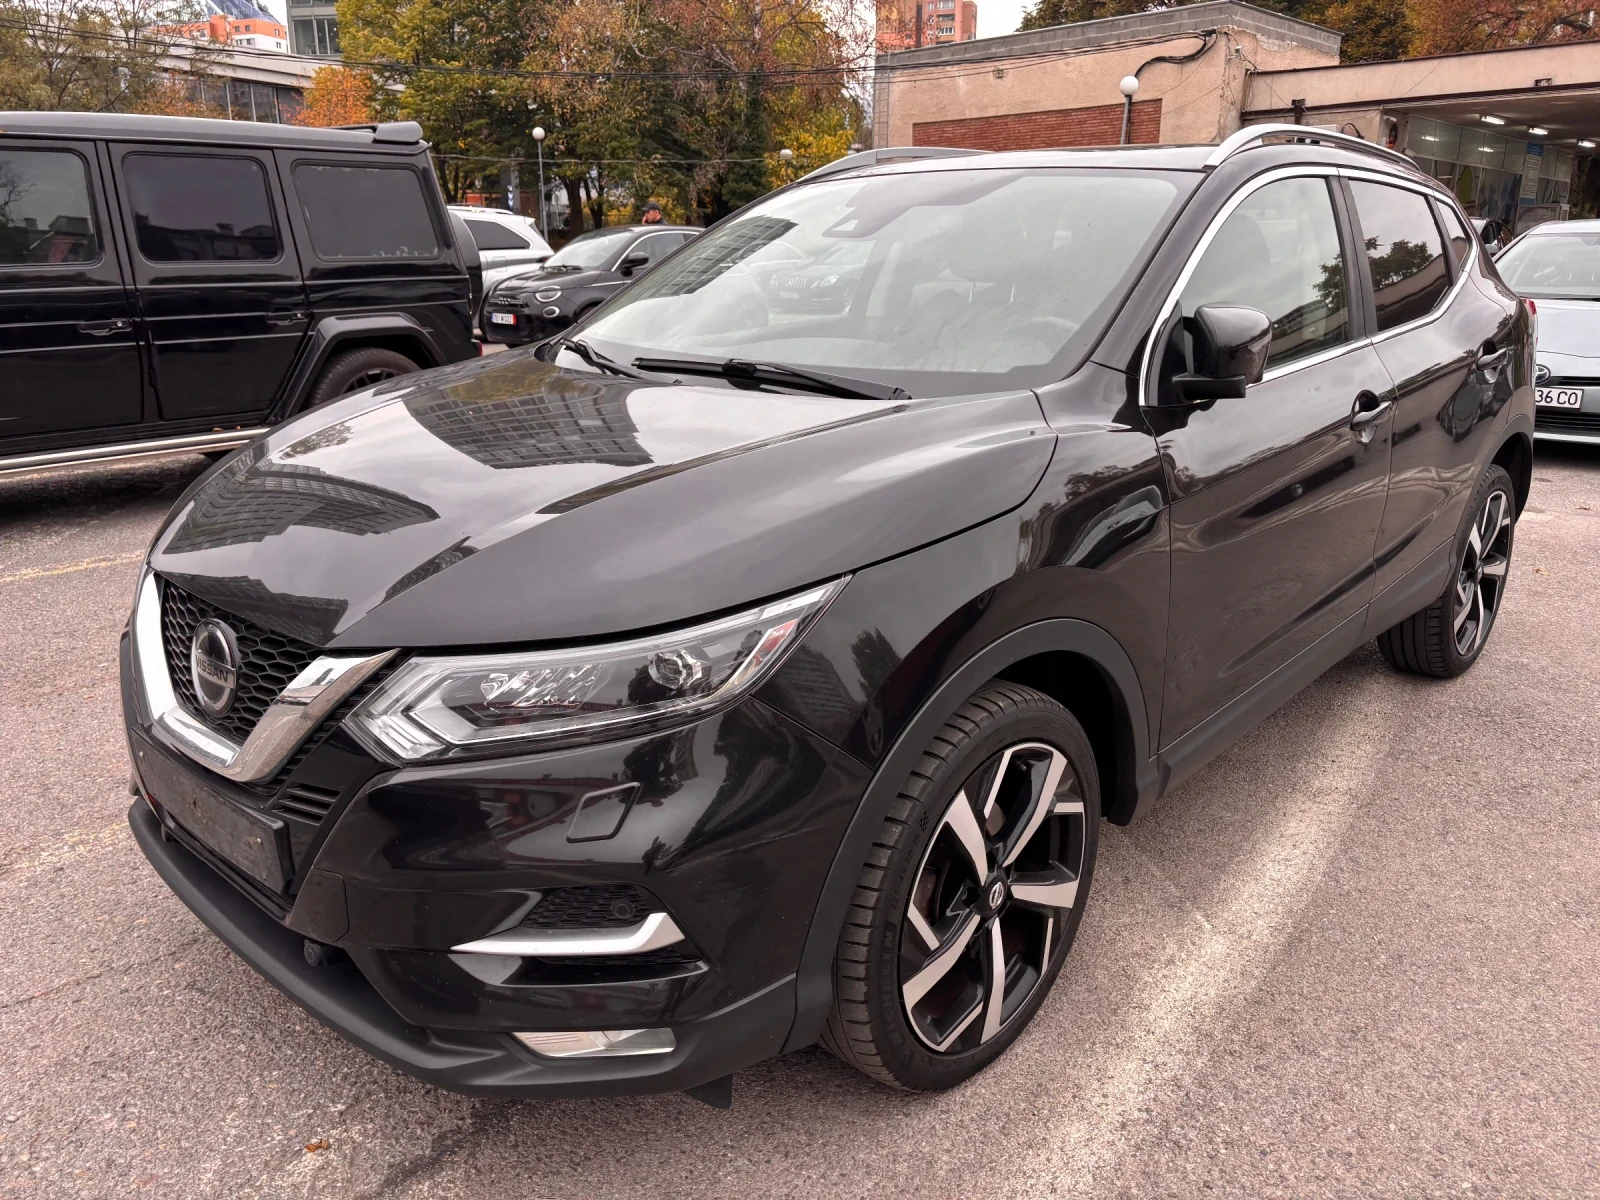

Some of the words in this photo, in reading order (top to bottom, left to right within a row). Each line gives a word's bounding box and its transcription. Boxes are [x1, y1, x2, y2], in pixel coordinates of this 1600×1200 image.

[1535, 390, 1553, 404] 36
[1557, 391, 1578, 406] CO
[196, 655, 228, 682] NISSAN
[912, 833, 920, 846] 19
[880, 930, 904, 1047] MICHELIN
